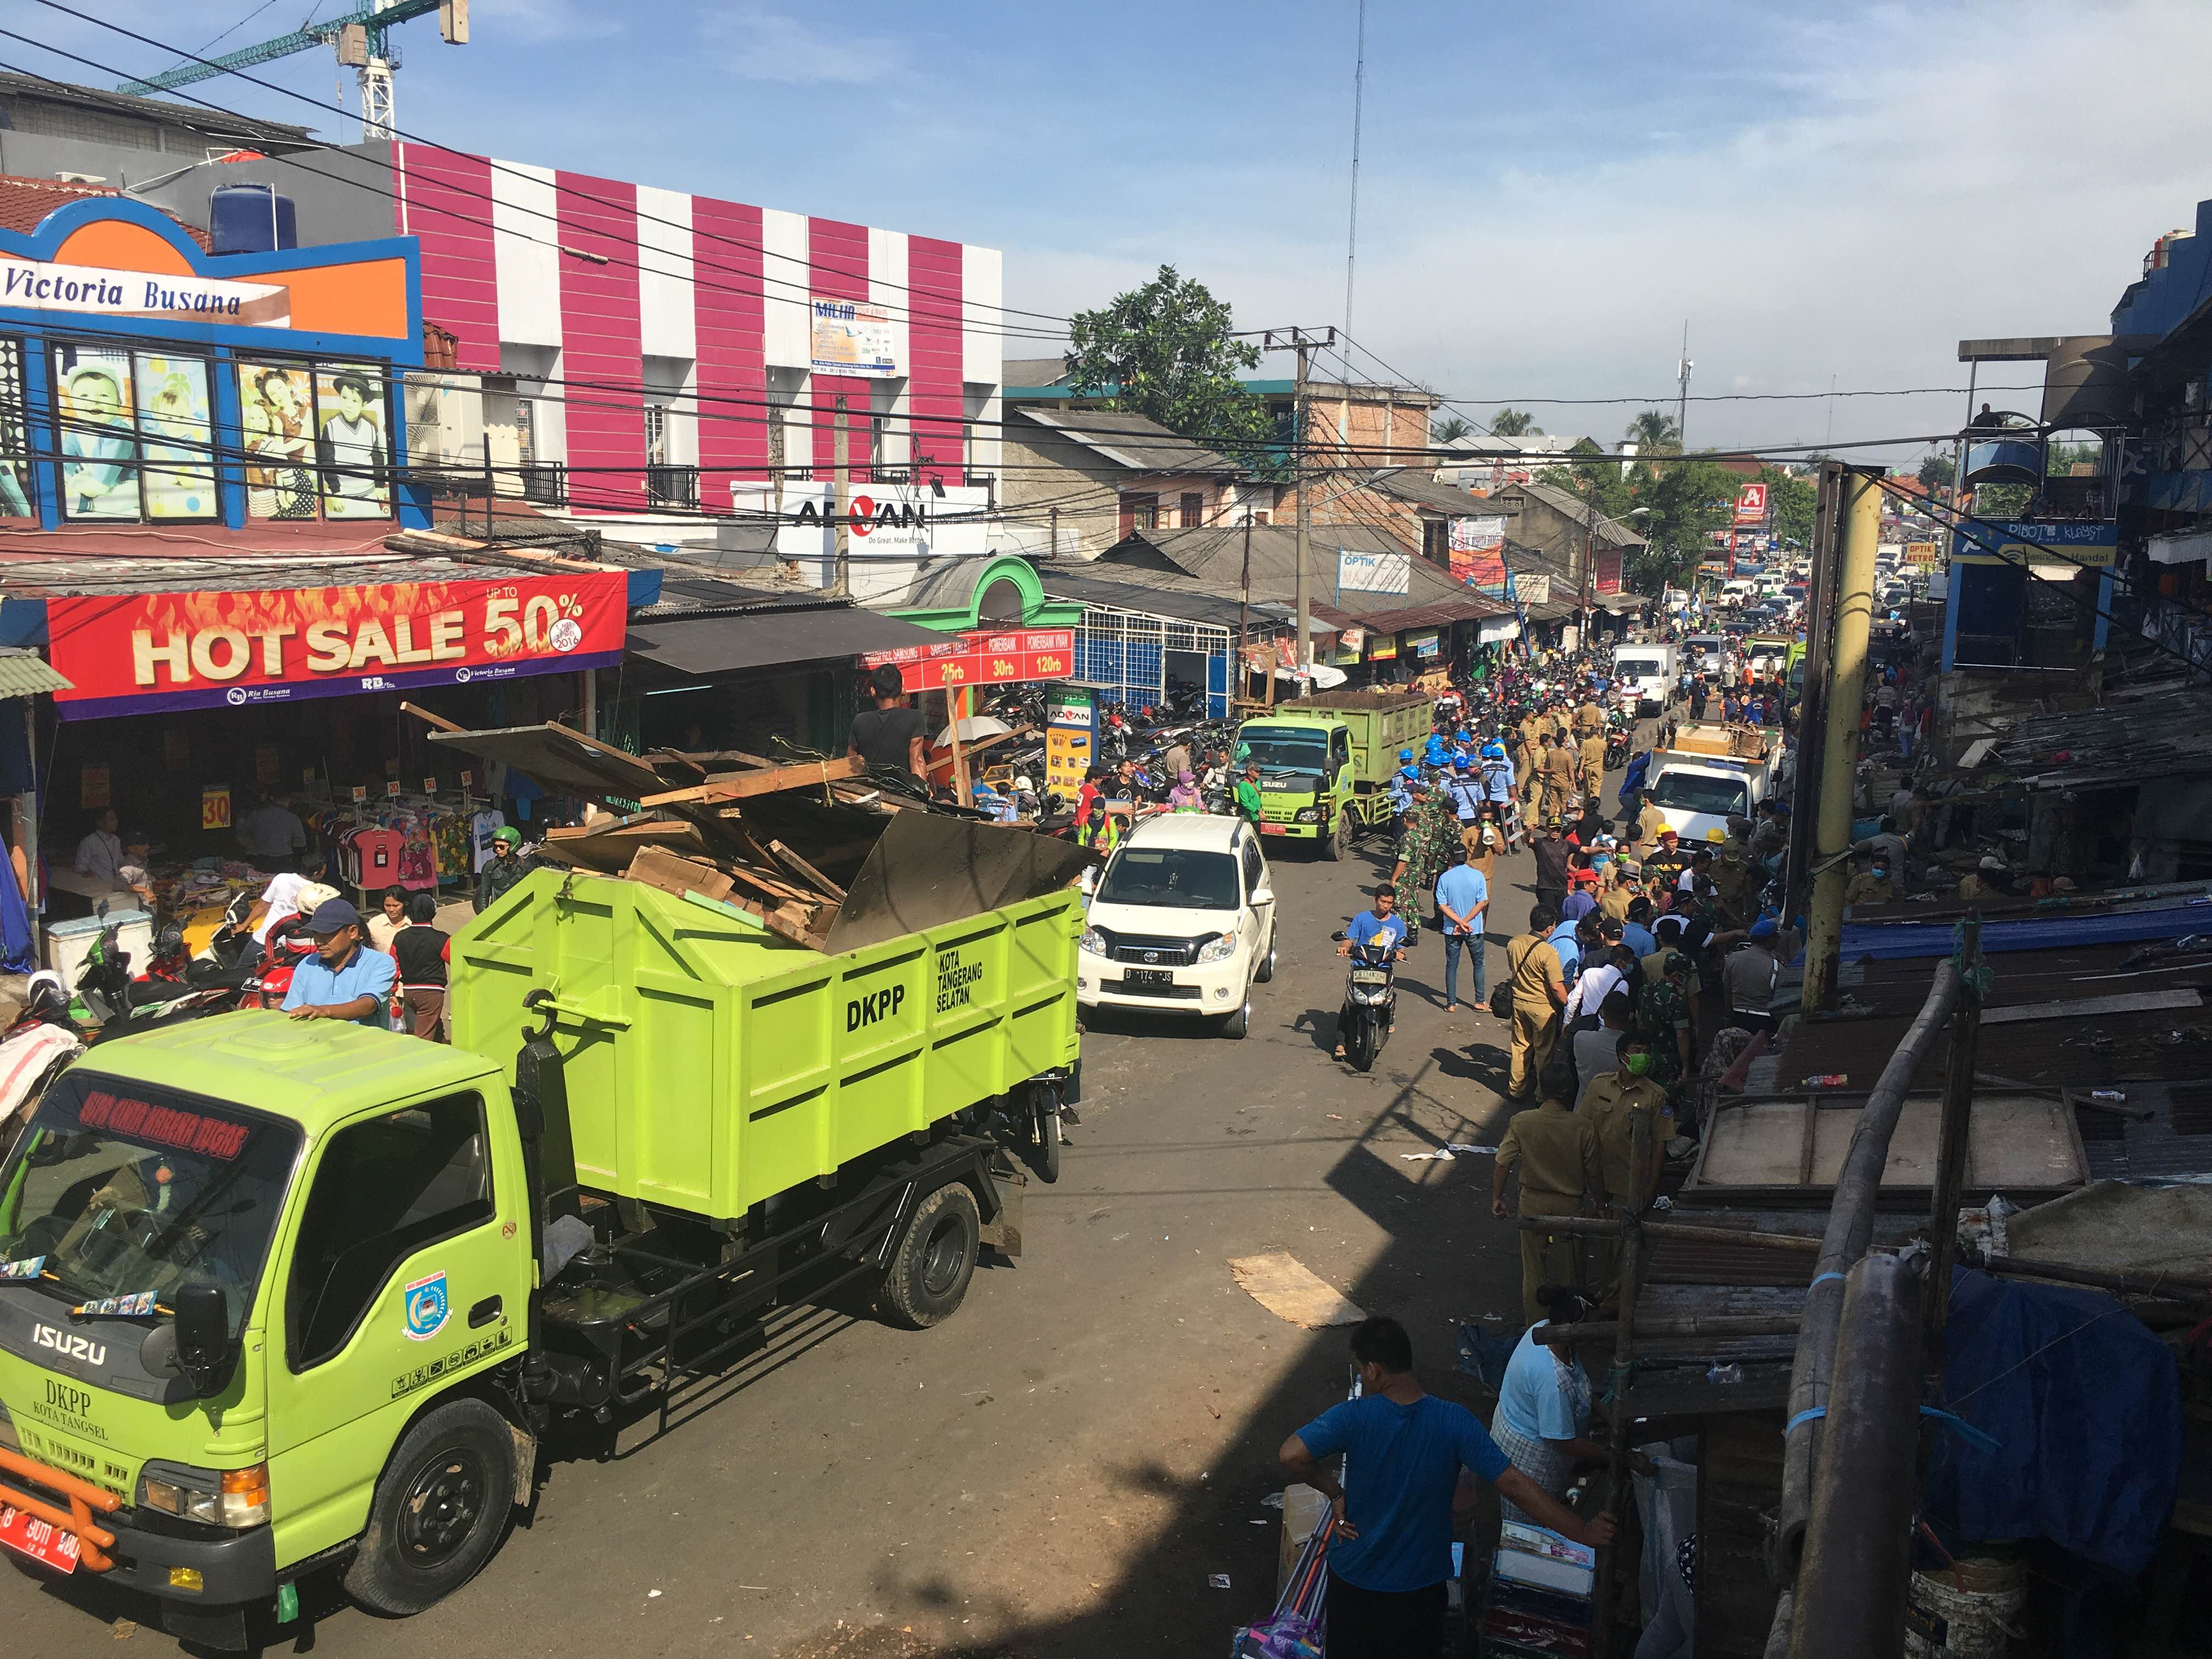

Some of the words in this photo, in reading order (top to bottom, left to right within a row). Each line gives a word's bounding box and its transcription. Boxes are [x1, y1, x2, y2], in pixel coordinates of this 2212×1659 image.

[6, 268, 123, 305] Victoria
[144, 281, 241, 315] Busana
[856, 307, 870, 315] TOUR
[874, 308, 888, 317] TRAVEL
[1344, 556, 1376, 567] OPTIK
[2072, 553, 2108, 562] Handal
[487, 588, 500, 599] UP
[503, 586, 517, 597] TO
[132, 623, 296, 685] HOT
[306, 609, 466, 672] SALE
[556, 636, 579, 648] 2016
[989, 637, 1017, 652] POWERBANK
[1027, 635, 1054, 650] POWERBANK
[1055, 634, 1068, 648] VIVAN
[941, 663, 964, 681] 25rb
[993, 659, 1014, 677] 30rb
[1036, 656, 1062, 673] 120rb
[362, 677, 384, 691] RB
[1049, 710, 1089, 721] ADVAN
[355, 788, 364, 797] 30
[390, 783, 398, 793] 20
[426, 781, 435, 789] 50
[202, 795, 229, 824] 30
[939, 950, 960, 973] KOTA
[938, 961, 983, 994] TANGERANG
[1126, 969, 1131, 979] D
[1163, 972, 1171, 981] JS
[936, 986, 970, 1014] SELATAN
[847, 984, 905, 1033] DKPP
[193, 1116, 250, 1161] TUGAS
[33, 1323, 106, 1365] ISUZU
[46, 1379, 91, 1418] DKPP
[33, 1401, 59, 1422] KOTA
[60, 1412, 109, 1441] TANGSEL
[27, 1542, 36, 1552] 12
